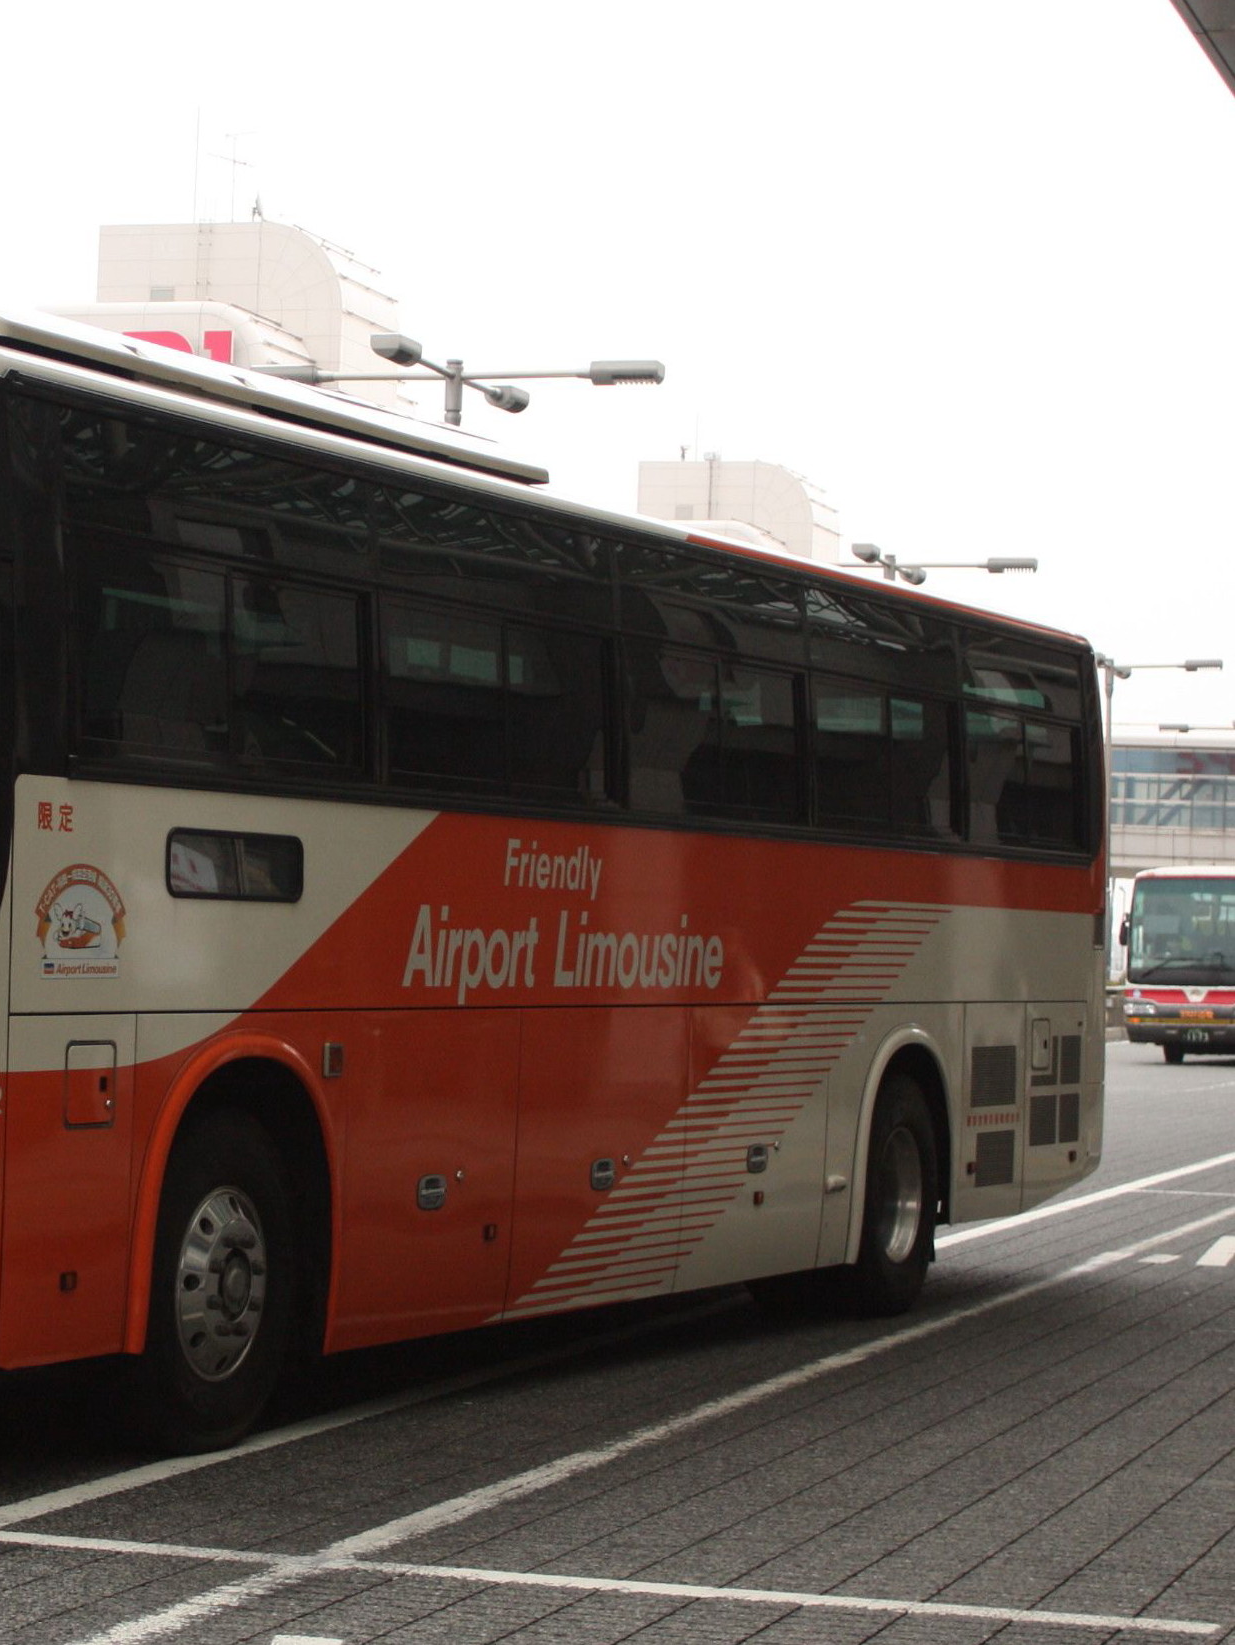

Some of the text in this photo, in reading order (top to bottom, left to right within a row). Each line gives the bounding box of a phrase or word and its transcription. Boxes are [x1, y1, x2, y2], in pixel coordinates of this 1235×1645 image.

[37, 801, 74, 832] 限定
[504, 838, 602, 900] Friendly
[56, 962, 117, 977] Airport Limousine
[402, 904, 724, 1005] Airport Limousine
